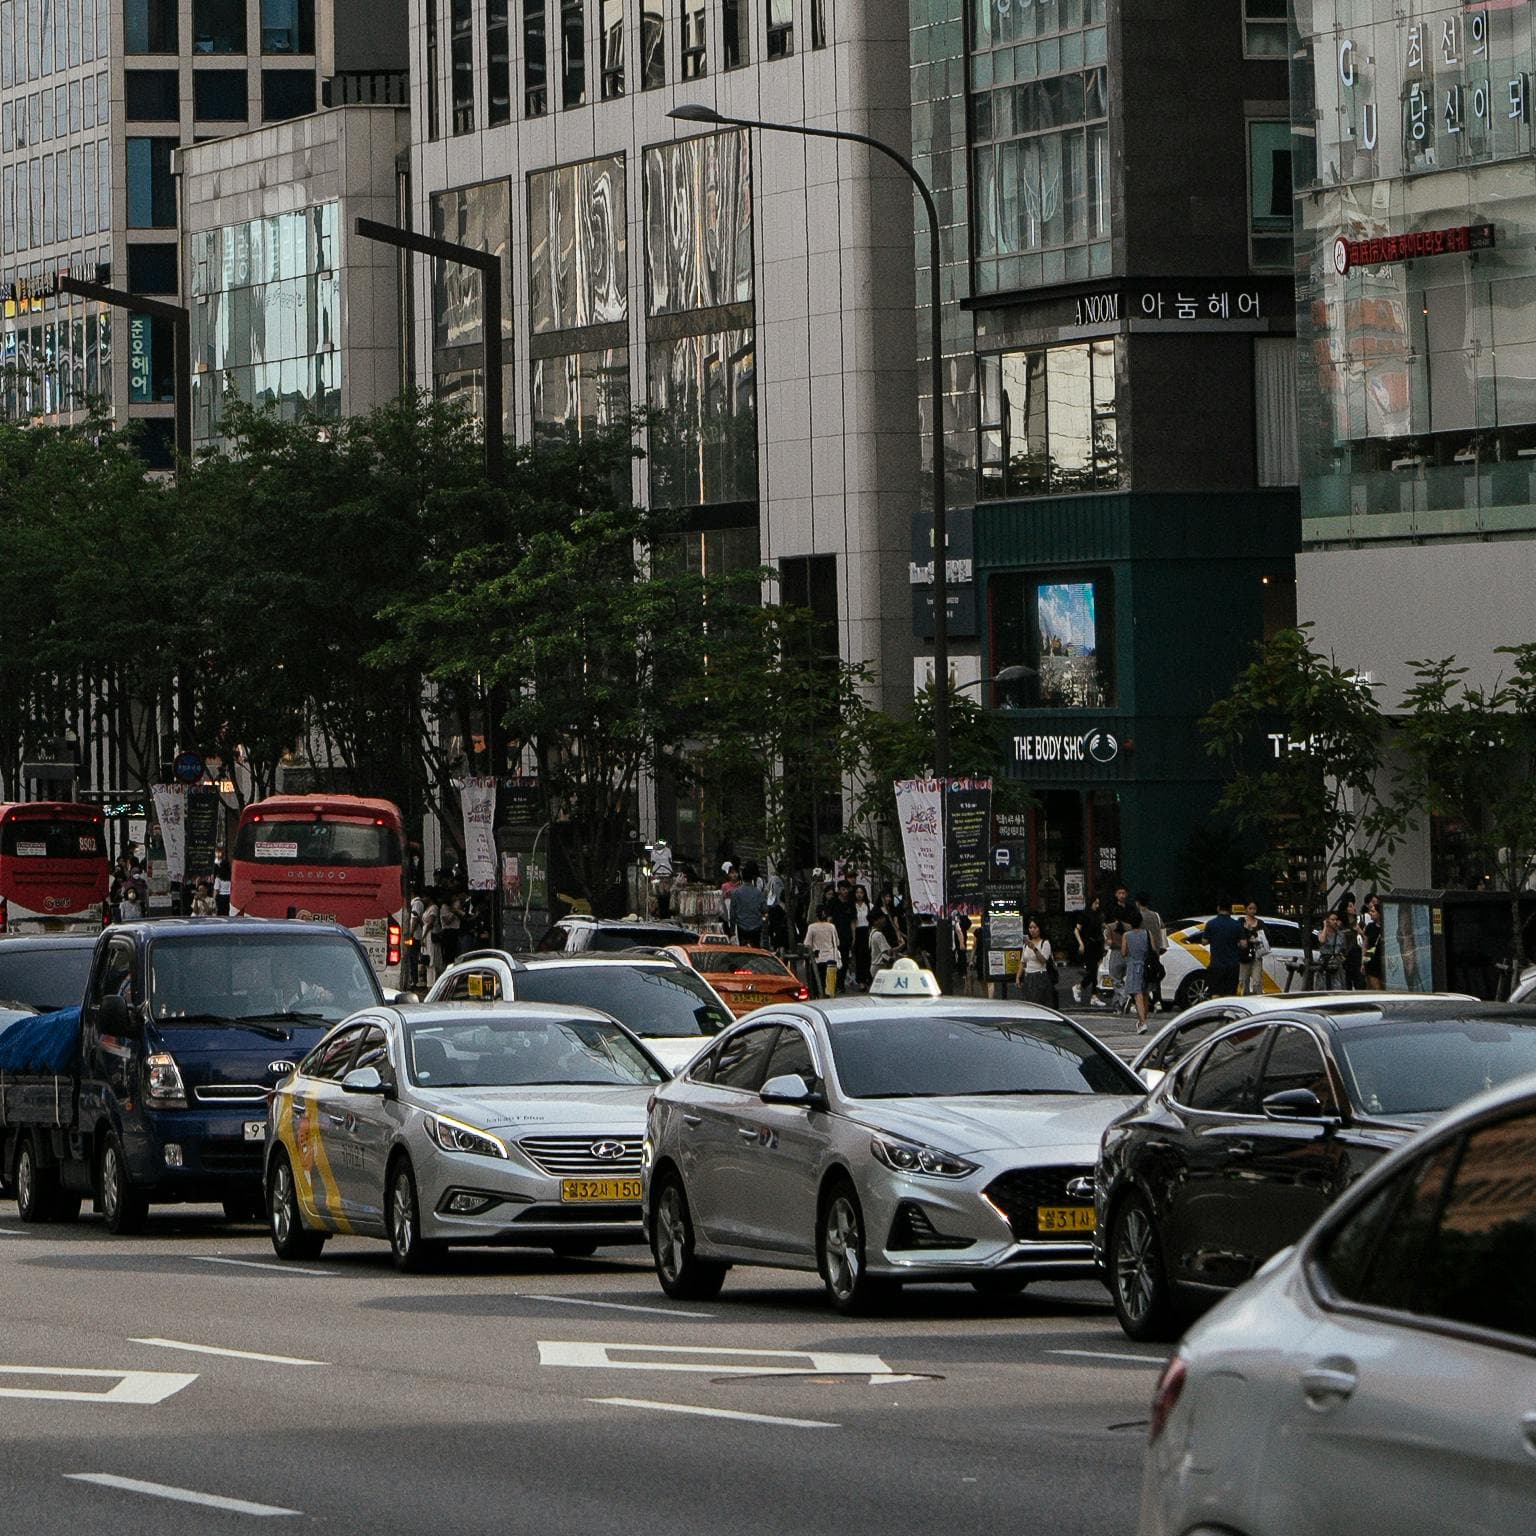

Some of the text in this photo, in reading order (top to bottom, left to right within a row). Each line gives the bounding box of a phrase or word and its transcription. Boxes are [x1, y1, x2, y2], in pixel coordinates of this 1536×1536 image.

[1408, 10, 1488, 72] 최선의
[1410, 79, 1492, 140] 당신이
[1084, 293, 1119, 325] NOOM
[1141, 291, 1261, 320] 아눔헤어
[131, 320, 149, 395] 준오헤어
[1014, 735, 1033, 761] THE
[1035, 735, 1062, 760] BODY
[288, 871, 346, 879] DAEWOO
[272, 1062, 293, 1072] KIA
[614, 1181, 642, 1198] 150
